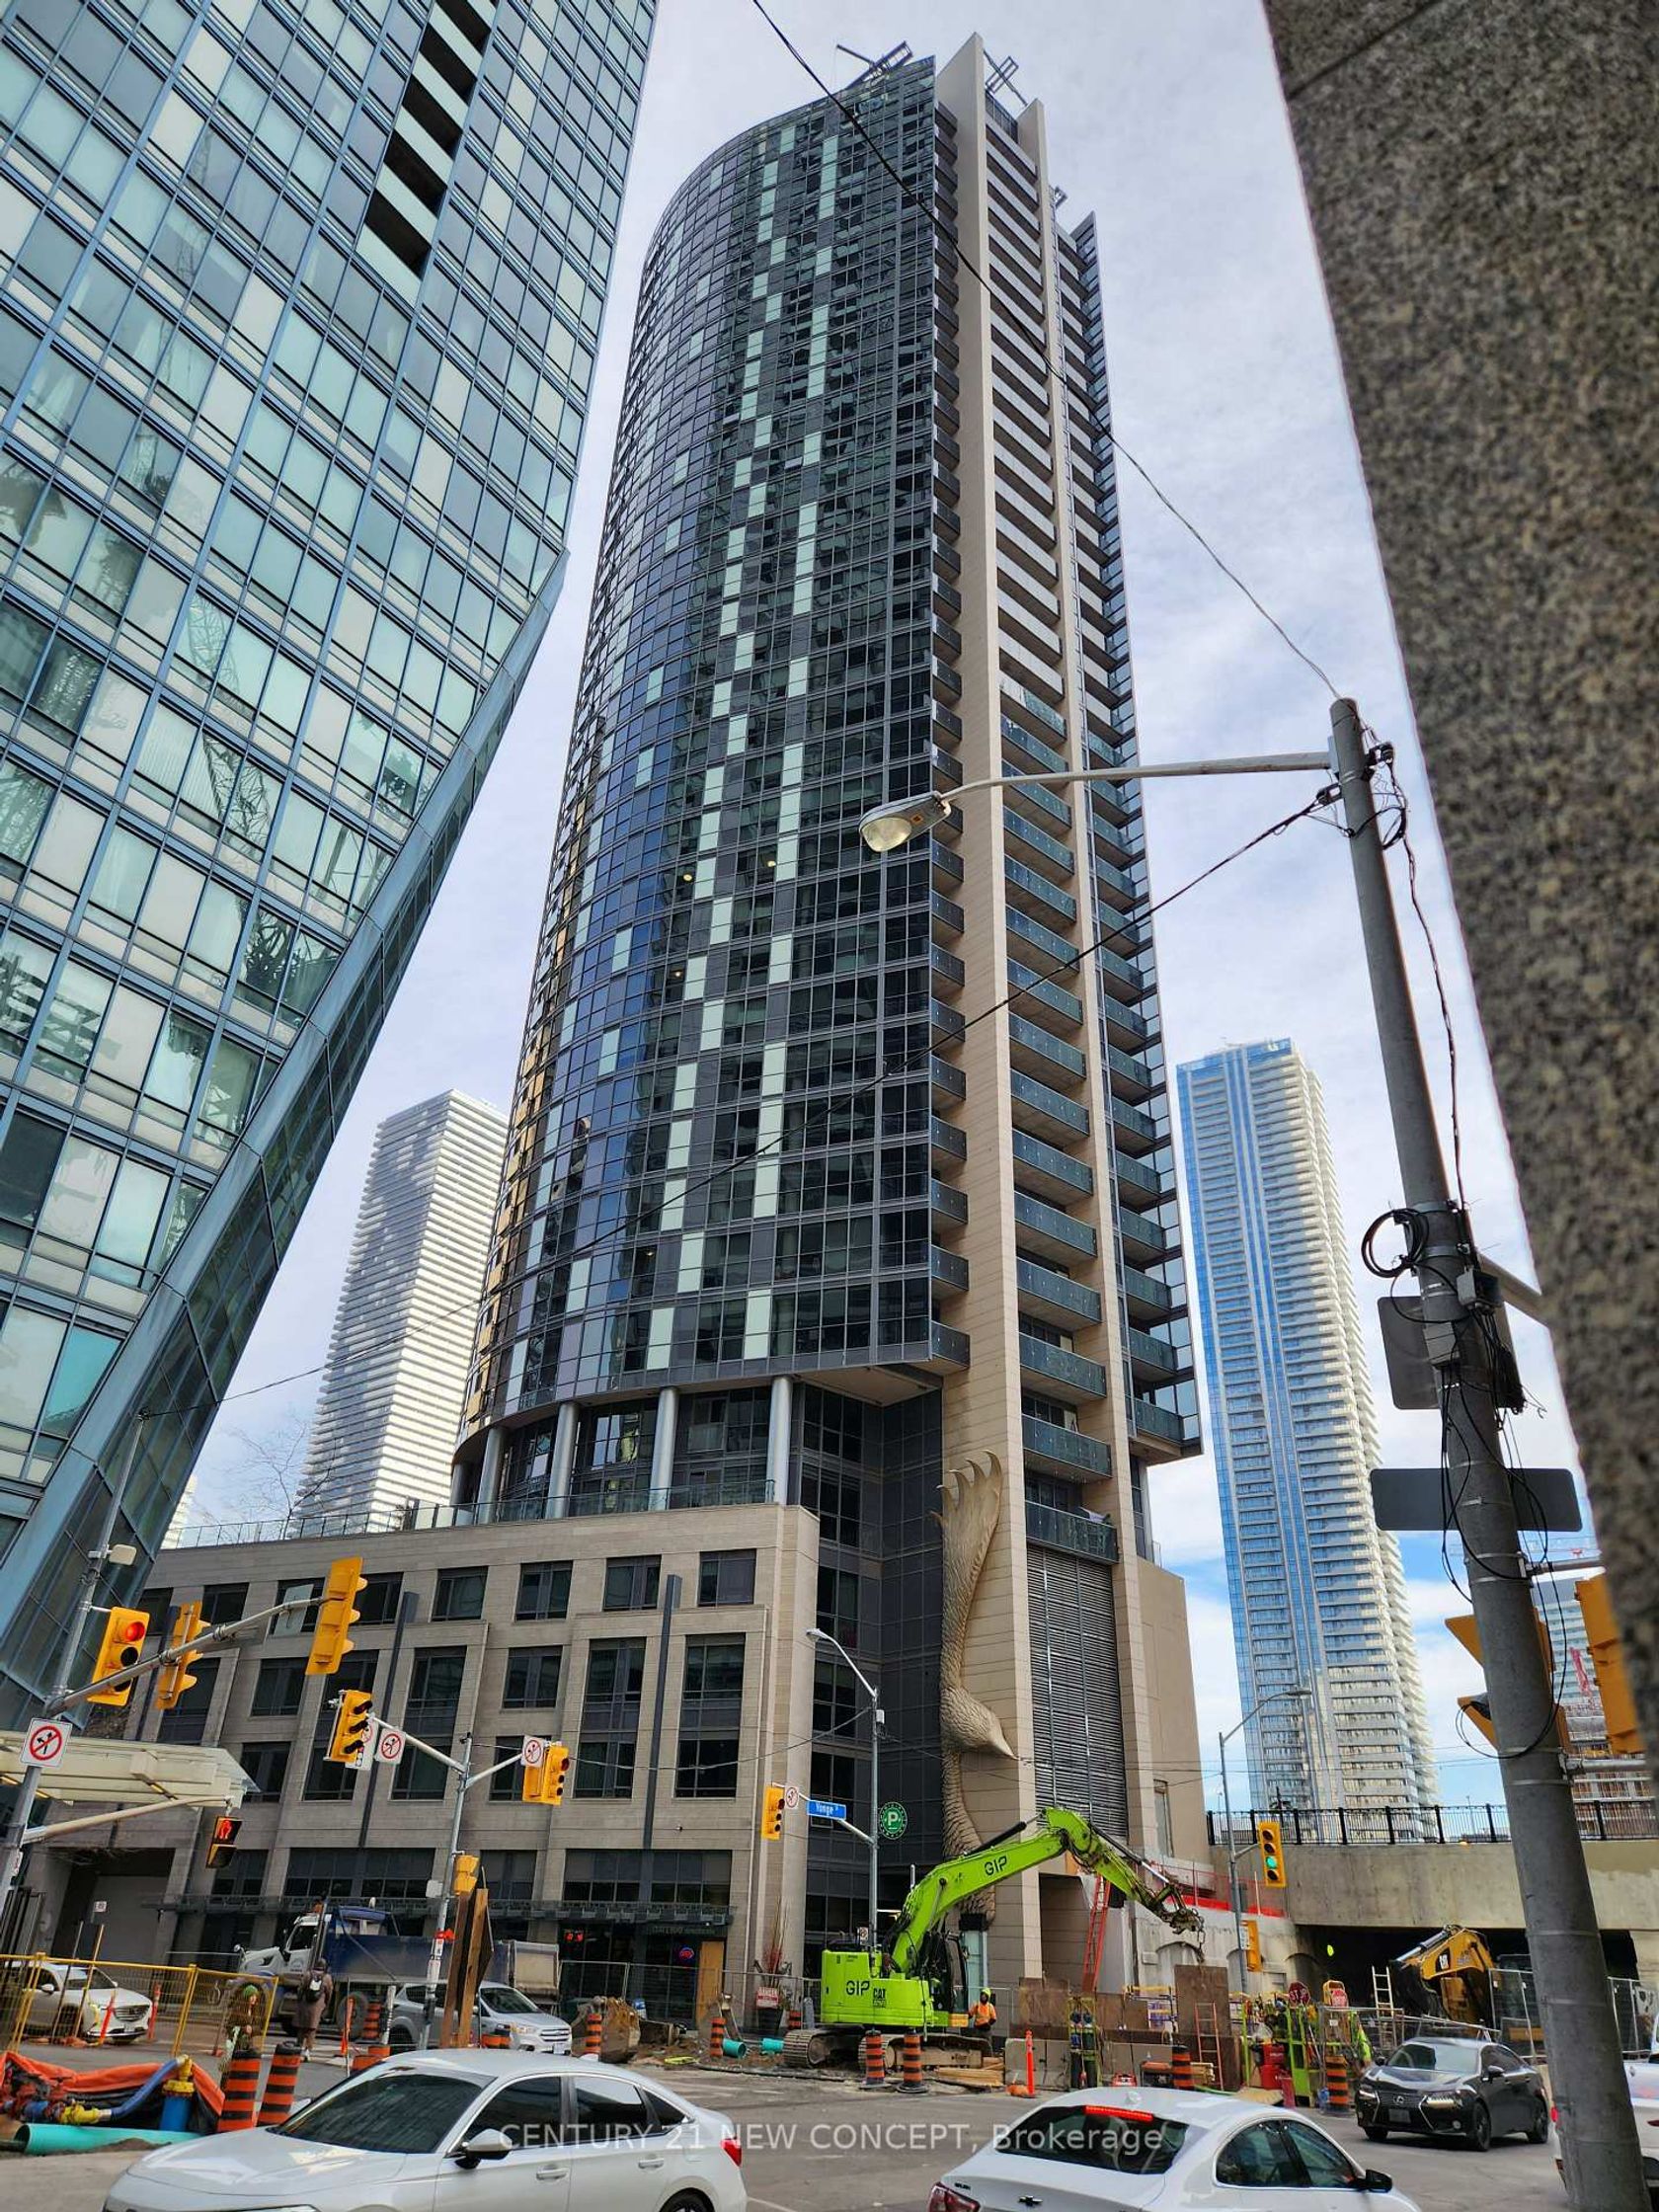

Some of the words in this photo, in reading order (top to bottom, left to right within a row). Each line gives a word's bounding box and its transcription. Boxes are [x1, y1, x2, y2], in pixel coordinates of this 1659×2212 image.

[816, 1802, 834, 1816] Yonge
[887, 1811, 899, 1826] P
[985, 1856, 1007, 1875] GIP
[845, 1980, 870, 1996] GIP
